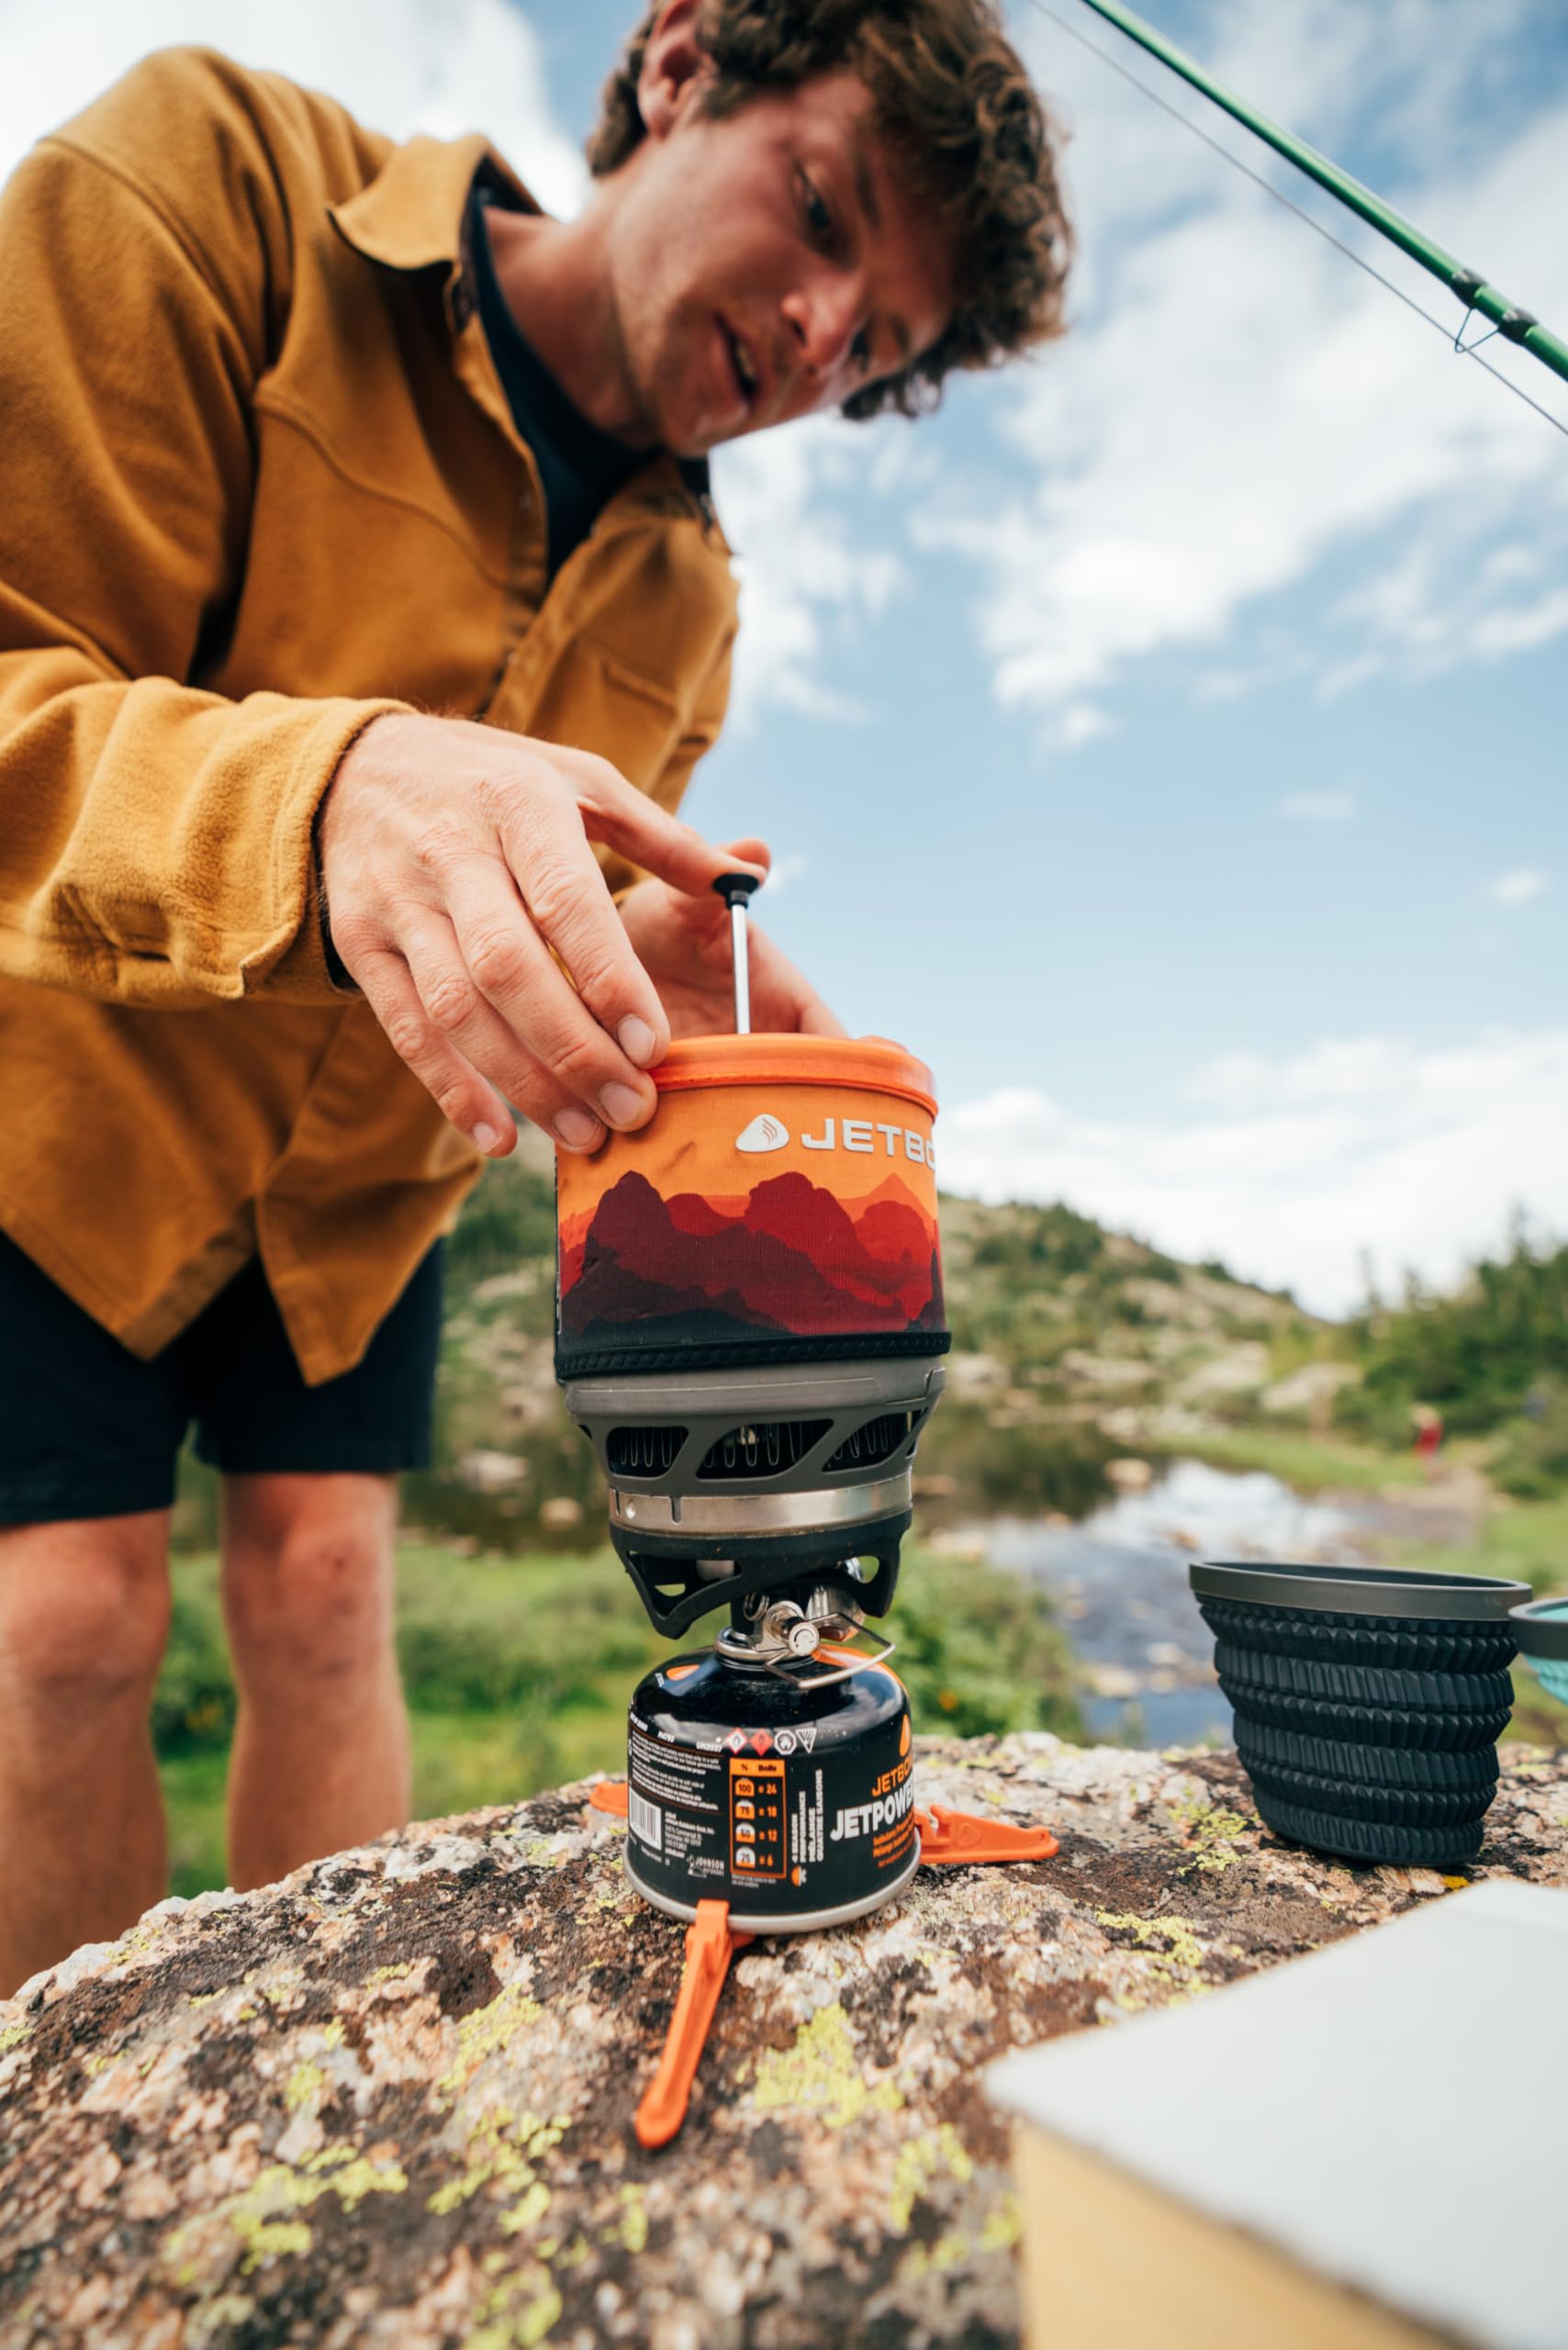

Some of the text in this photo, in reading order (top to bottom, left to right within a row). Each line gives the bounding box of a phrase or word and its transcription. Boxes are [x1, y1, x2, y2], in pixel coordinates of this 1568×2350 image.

[738, 1785, 751, 1793] 100
[767, 1783, 777, 1795] 24
[815, 1769, 823, 1815] SAISONS
[740, 1806, 750, 1815] 75
[741, 1829, 750, 1838] 50
[767, 1829, 778, 1842] 12
[696, 1856, 724, 1869] JOHNSON
[741, 1853, 751, 1863] 25
[767, 1855, 773, 1867] 6
